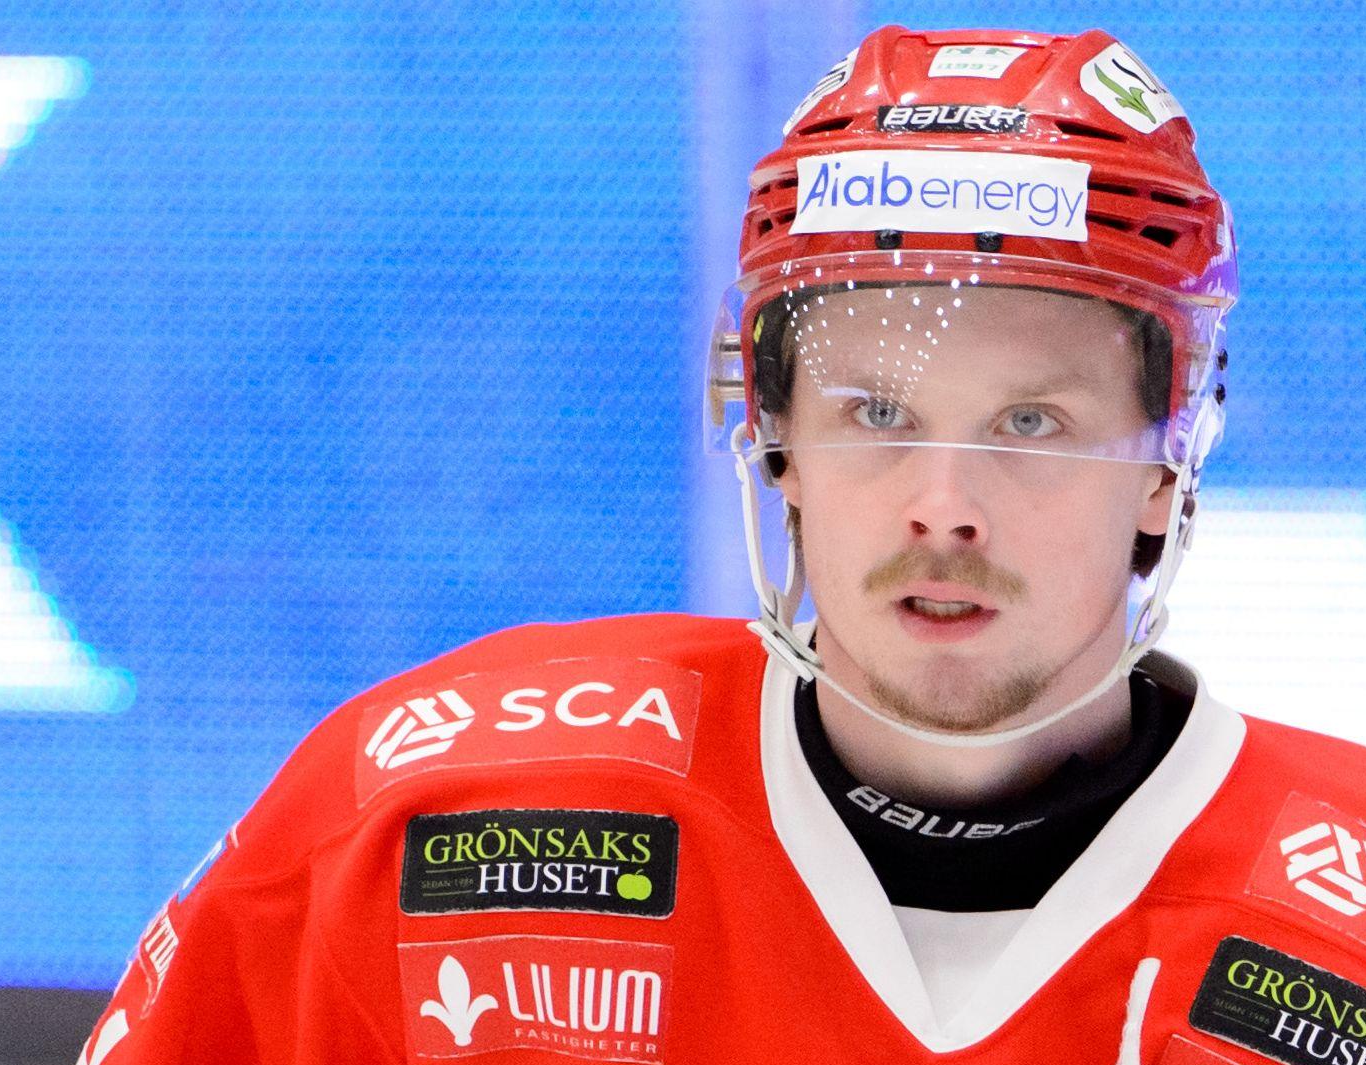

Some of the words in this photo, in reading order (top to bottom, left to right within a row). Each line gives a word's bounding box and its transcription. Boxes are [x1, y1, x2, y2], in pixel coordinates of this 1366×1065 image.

[799, 161, 913, 213] Aiab
[921, 174, 1084, 227] energy
[495, 681, 684, 742] SCA
[423, 822, 652, 865] GRÖNSAKS
[476, 862, 620, 897] HUSET
[502, 962, 662, 1036] LILIUM
[514, 1027, 657, 1054] FASTIGHETER
